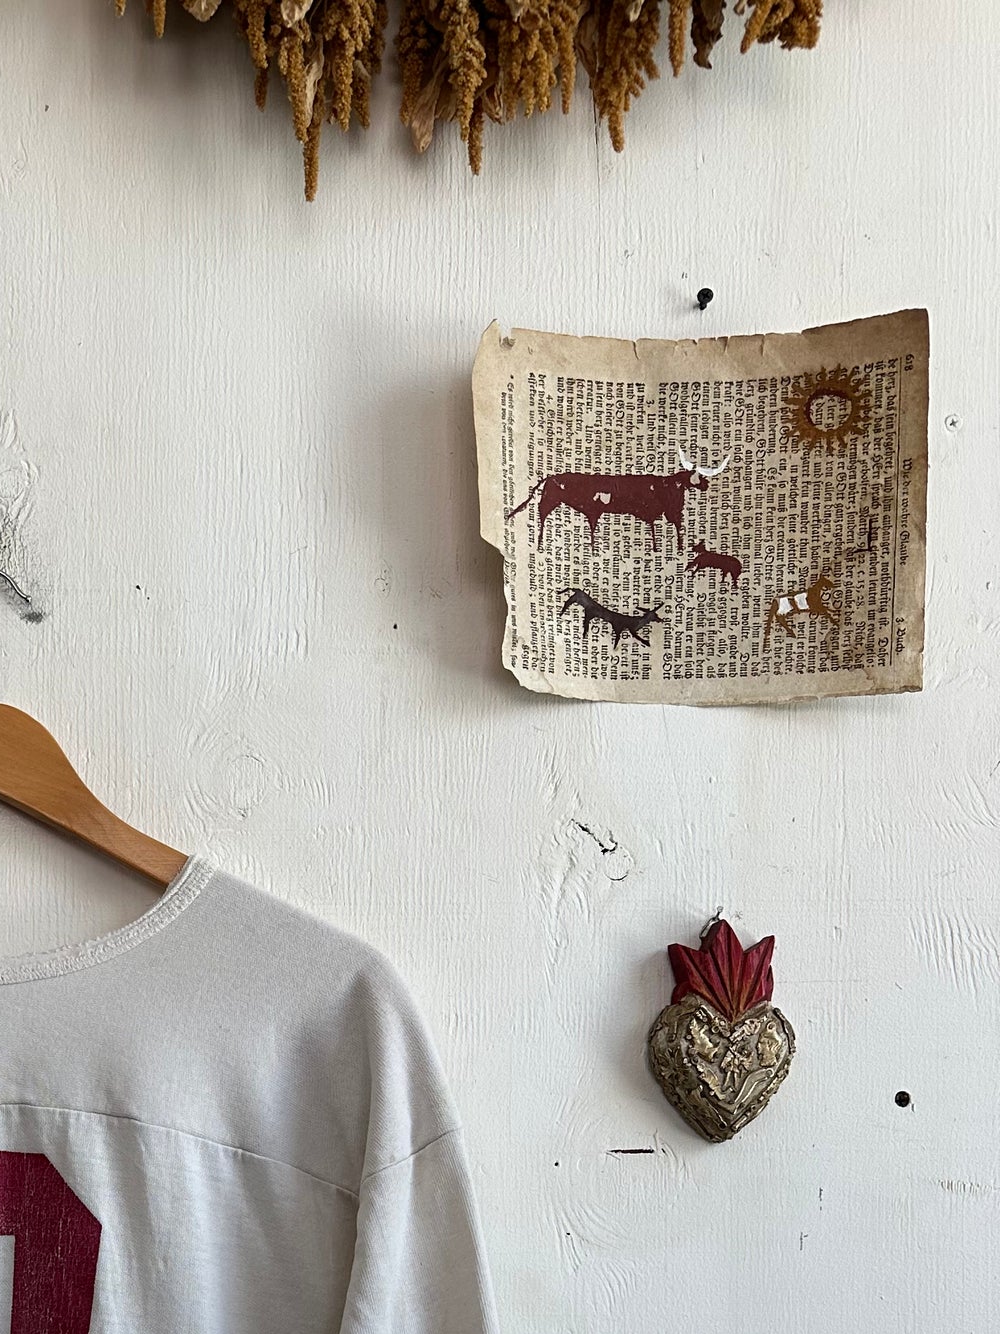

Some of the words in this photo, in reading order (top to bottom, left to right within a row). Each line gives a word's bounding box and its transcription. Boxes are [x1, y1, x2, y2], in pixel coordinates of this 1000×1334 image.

[904, 354, 914, 371] 618
[903, 458, 912, 478] Wie
[901, 498, 911, 528] wahre
[899, 531, 910, 566] Glaube
